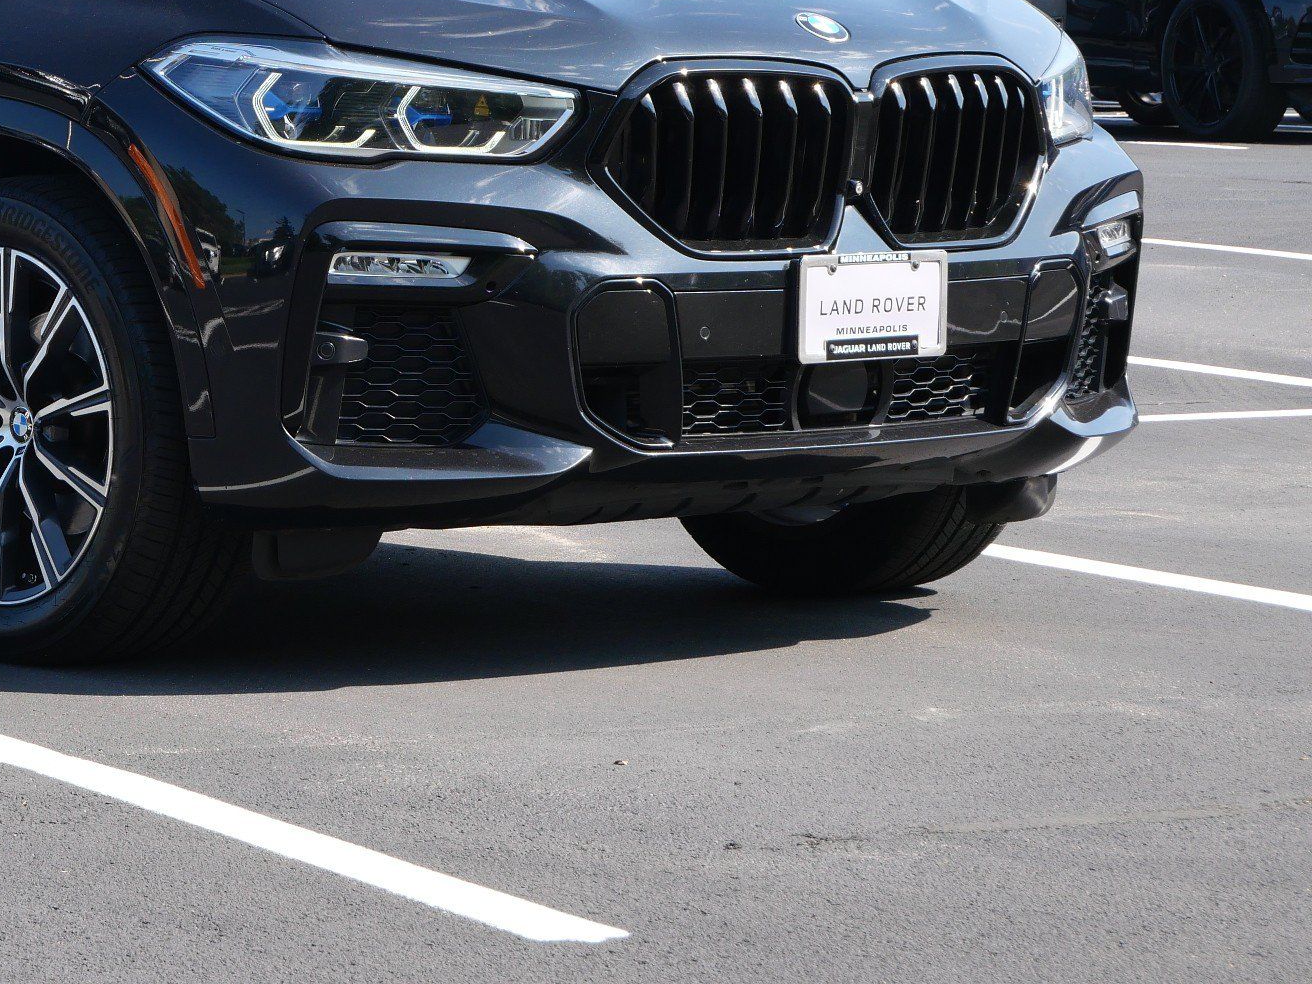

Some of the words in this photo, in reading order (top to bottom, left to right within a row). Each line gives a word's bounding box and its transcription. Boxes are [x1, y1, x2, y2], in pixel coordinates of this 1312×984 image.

[840, 253, 909, 263] MINNEAPOLIS
[820, 299, 864, 316] LAND
[871, 296, 926, 313] ROVER
[836, 324, 908, 335] MINNEAPOLIS
[833, 344, 866, 354] JAGUAR
[867, 343, 886, 352] LAND
[887, 341, 911, 351] ROVER
